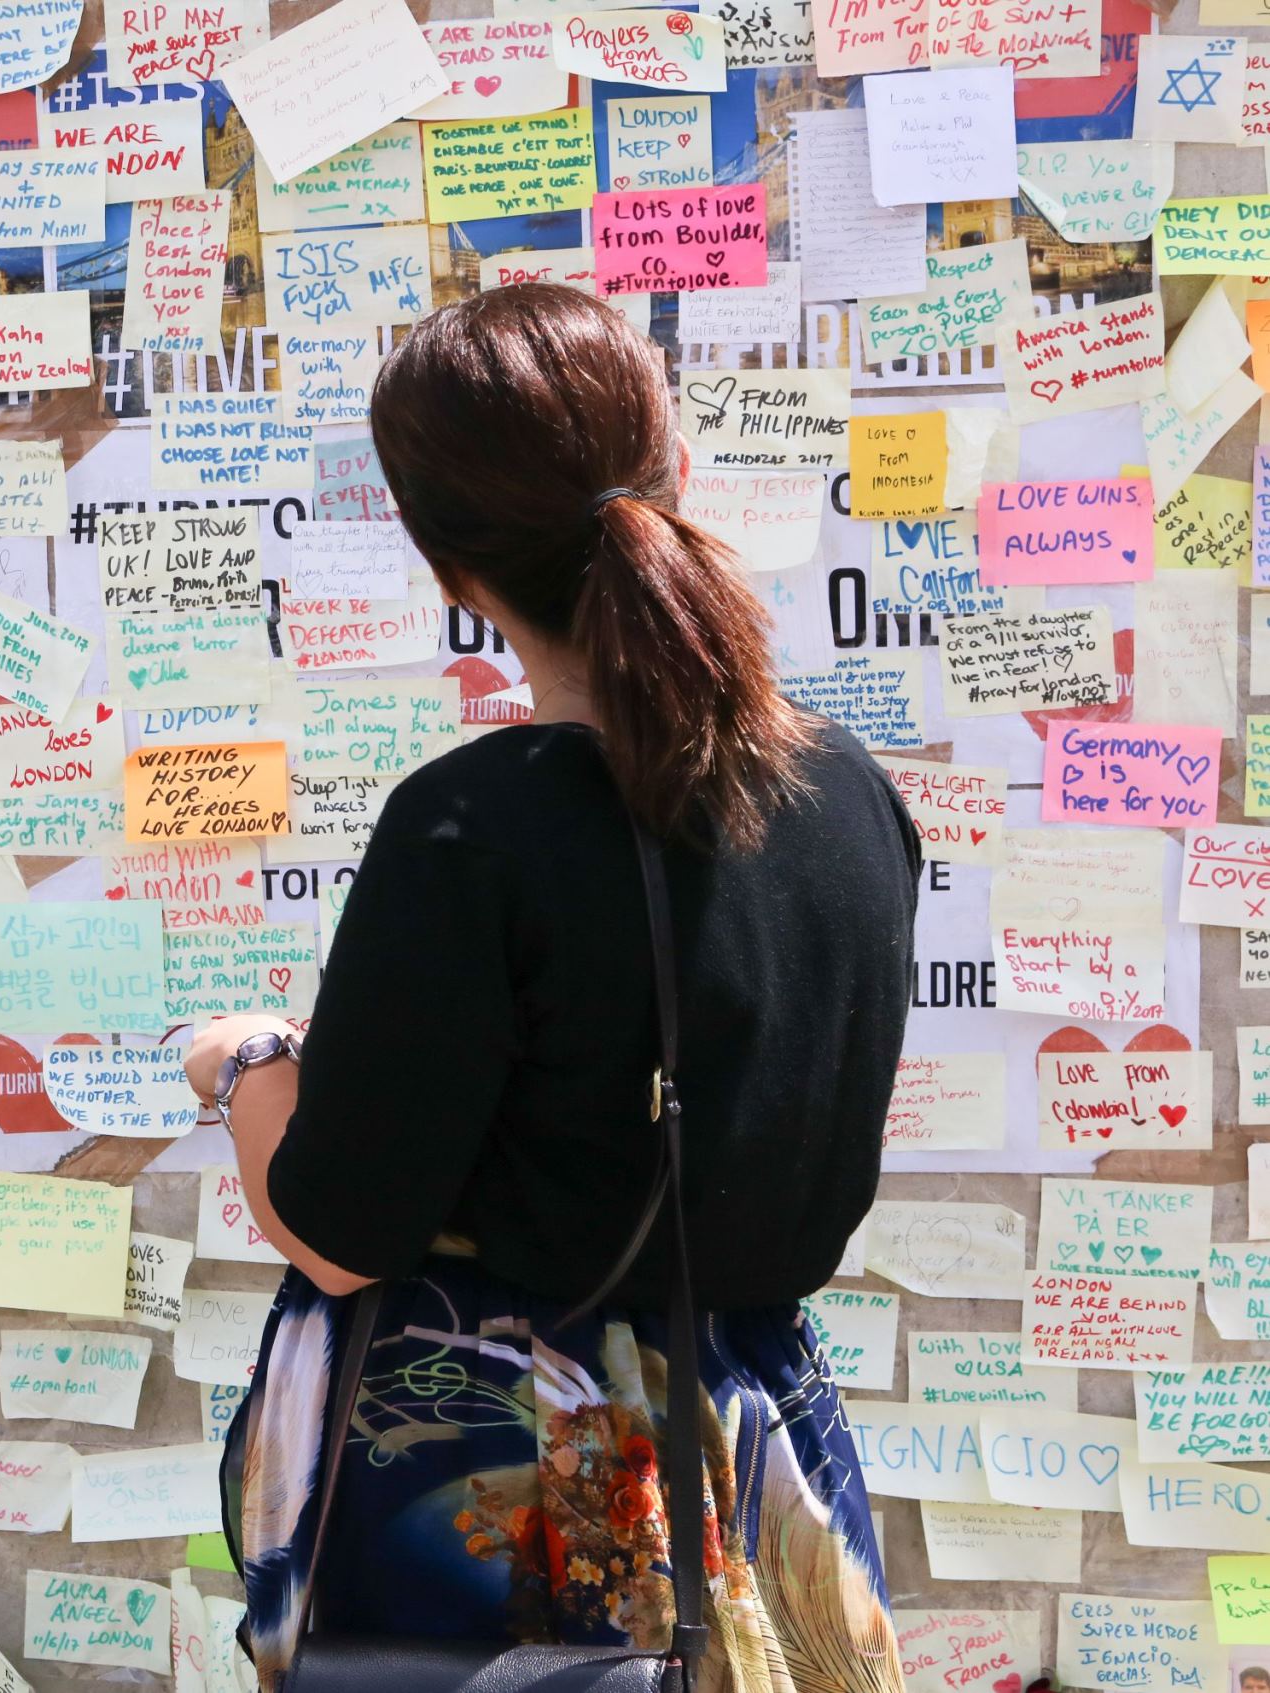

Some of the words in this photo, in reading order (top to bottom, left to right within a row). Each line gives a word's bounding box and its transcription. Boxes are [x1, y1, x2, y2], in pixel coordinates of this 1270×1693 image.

[566, 18, 649, 46] Prayers
[618, 107, 698, 128] LONDON
[104, 124, 162, 145] ARE
[618, 139, 670, 159] KEEP
[638, 168, 710, 185] STRONG
[683, 198, 708, 217] of
[716, 196, 755, 216] love
[1162, 207, 1219, 223] THEY
[600, 227, 662, 247] from
[677, 223, 764, 245] Boulder,
[1016, 321, 1089, 355] America
[1095, 306, 1157, 327] stands
[1024, 346, 1064, 371] with
[177, 399, 216, 414] WAS
[222, 398, 276, 414] QUIET
[739, 389, 807, 409] FROM
[697, 413, 724, 435] THE
[739, 413, 850, 436] PHILIPPINES
[868, 429, 897, 441] LOVE
[161, 447, 224, 464] CHOOSE
[231, 446, 270, 462] LOVE
[276, 448, 309, 462] NOT
[799, 453, 833, 466] 2017
[200, 465, 259, 483] HATE!
[998, 485, 1070, 511] LOVE
[101, 521, 155, 547] KEEP
[172, 519, 246, 541] STRONG
[1005, 530, 1112, 557] ALWAYS
[107, 549, 149, 578] UK!
[166, 549, 212, 572] LOVE
[220, 548, 255, 568] AND
[105, 586, 155, 606] PEACE
[1062, 728, 1181, 765] Germany
[138, 748, 239, 767] WRITING
[10, 760, 92, 788] LONDON
[152, 764, 256, 787] HISTORY
[1101, 762, 1126, 783] is
[173, 801, 259, 818] HEROES
[1063, 790, 1109, 812] here
[1121, 788, 1154, 811] for
[1161, 795, 1206, 818] you
[141, 819, 188, 837] LOVE
[201, 818, 269, 835] LONDON
[1004, 929, 1112, 960] Everything
[1032, 1276, 1112, 1292] LONDON
[1035, 1295, 1061, 1306] WE
[1071, 1295, 1109, 1309] ARE
[1120, 1298, 1186, 1311] BEHIND
[977, 1362, 1023, 1377] USA
[853, 1424, 1065, 1479] IGNACIO
[87, 1630, 153, 1651] LONDON
